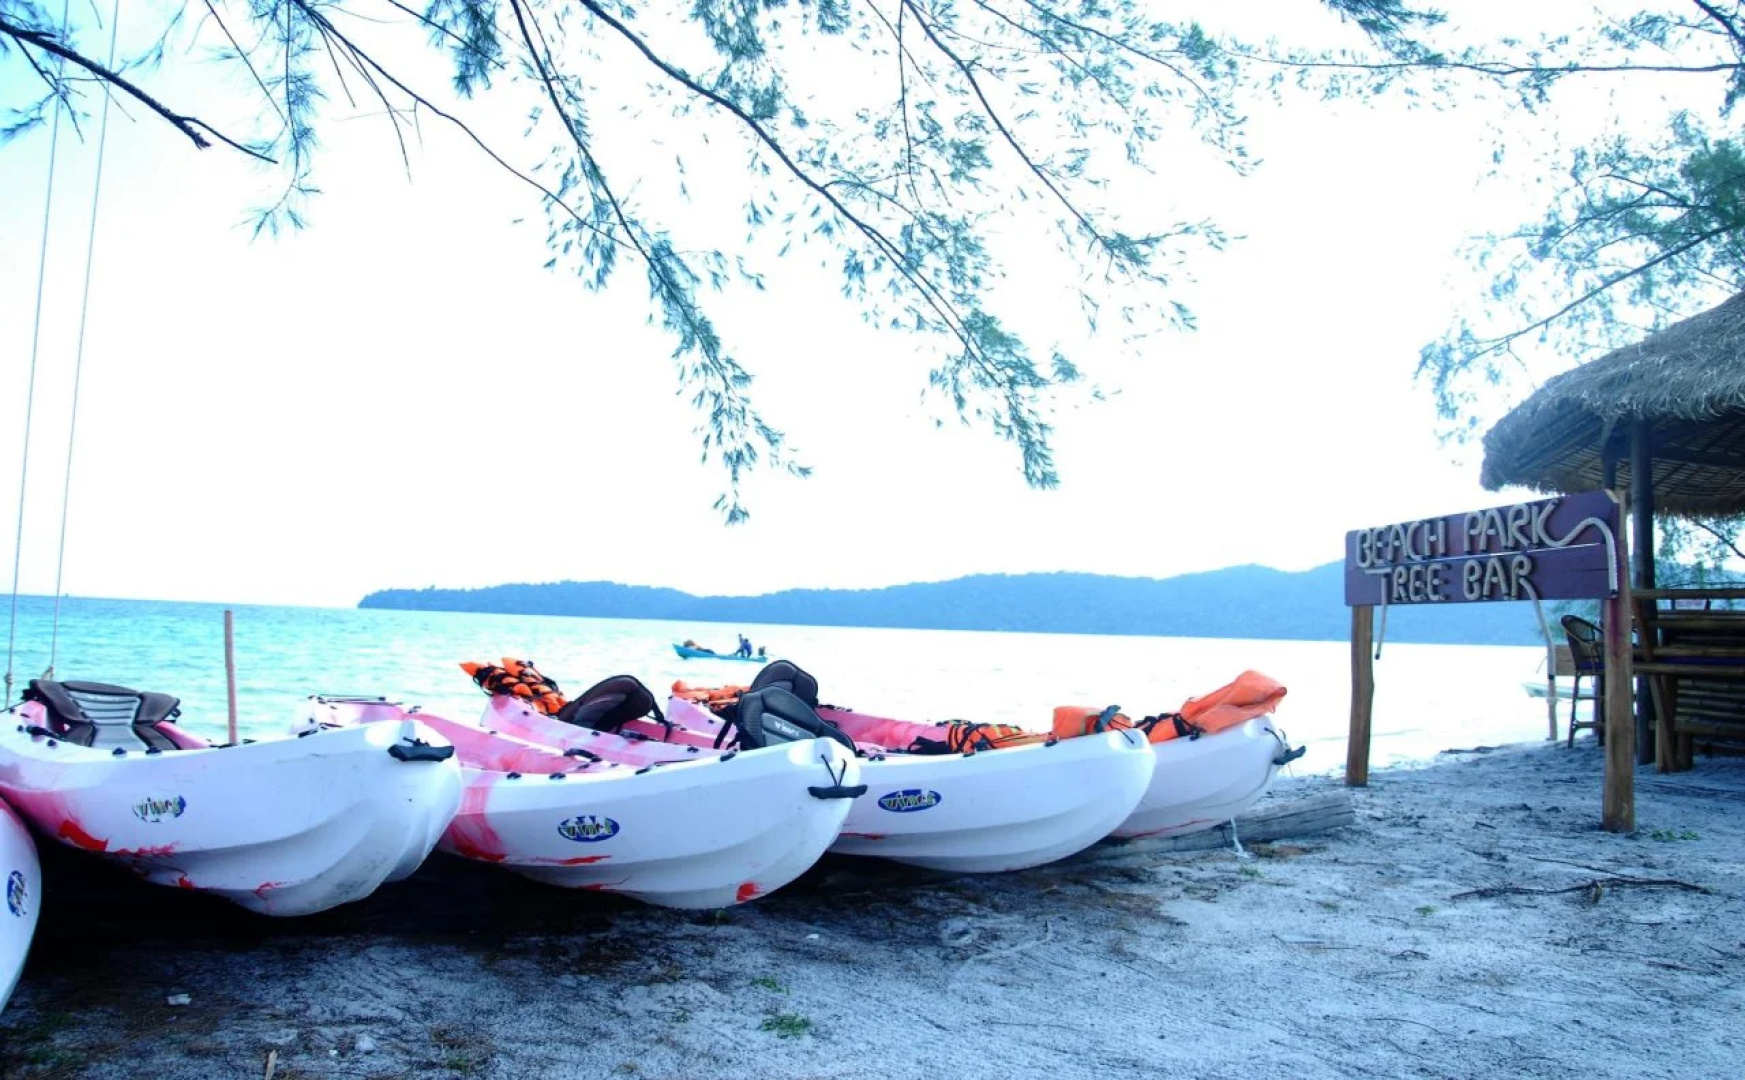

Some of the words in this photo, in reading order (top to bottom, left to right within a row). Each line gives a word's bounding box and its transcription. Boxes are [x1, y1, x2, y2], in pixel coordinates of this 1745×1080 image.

[1356, 520, 1446, 568] BEACH
[1463, 500, 1560, 552] PARK
[1364, 562, 1446, 605] TREE
[1462, 554, 1538, 602] BAR
